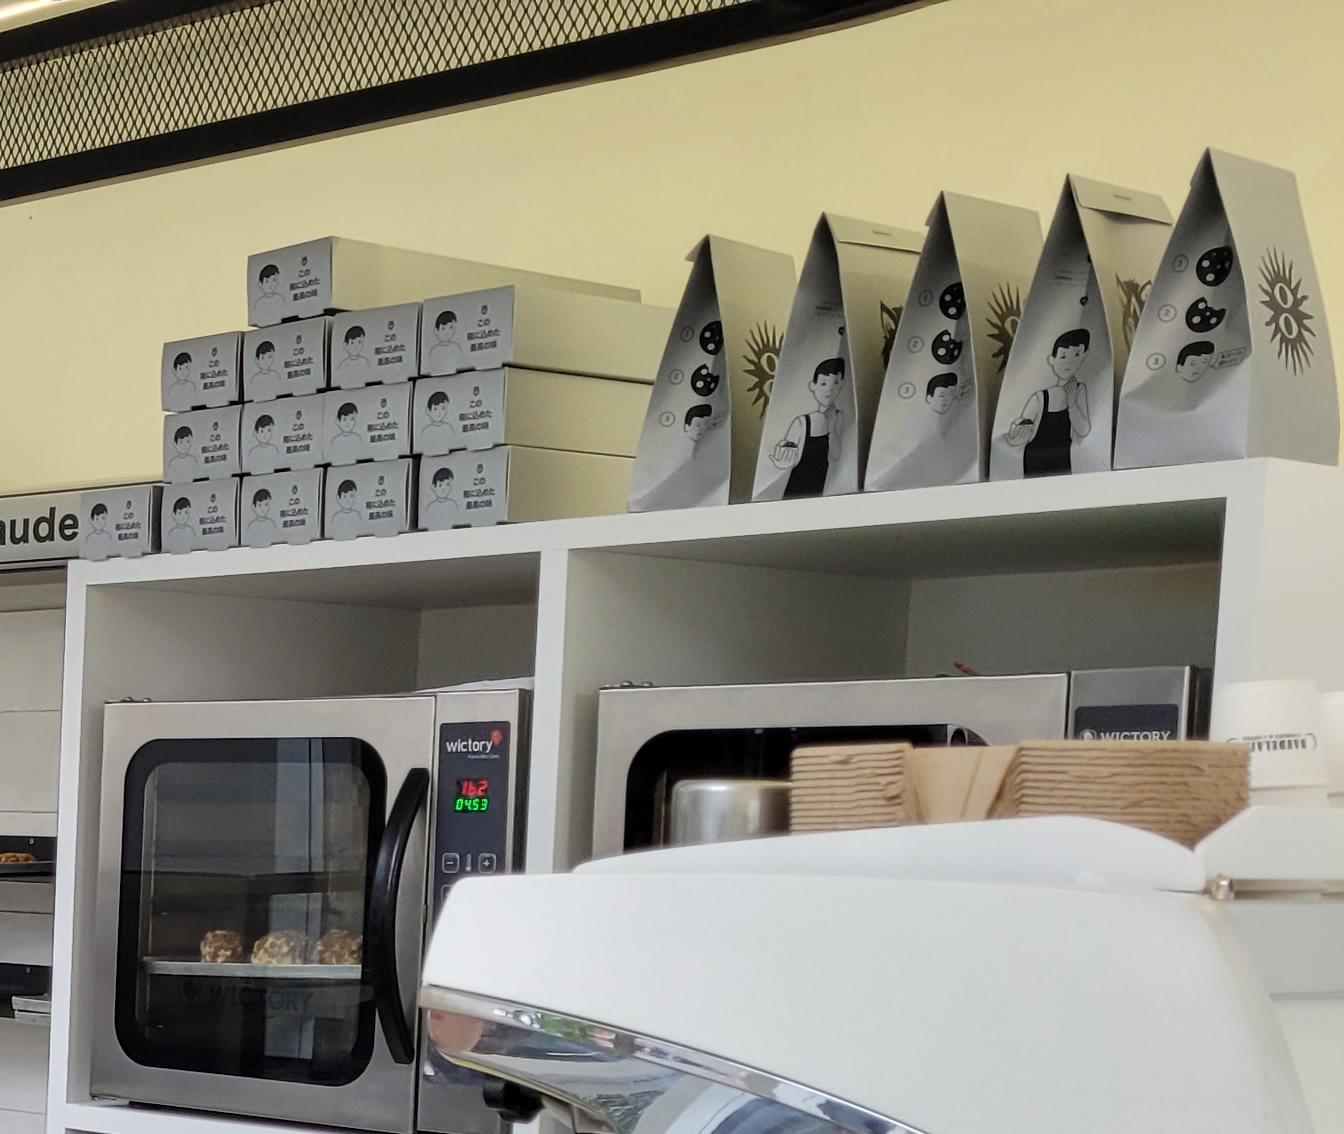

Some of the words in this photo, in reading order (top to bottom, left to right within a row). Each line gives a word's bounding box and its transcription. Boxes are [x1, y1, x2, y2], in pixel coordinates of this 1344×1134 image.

[1100, 730, 1172, 741] WICTORY
[446, 738, 494, 753] wictory
[1249, 739, 1308, 752] BAUDELAI
